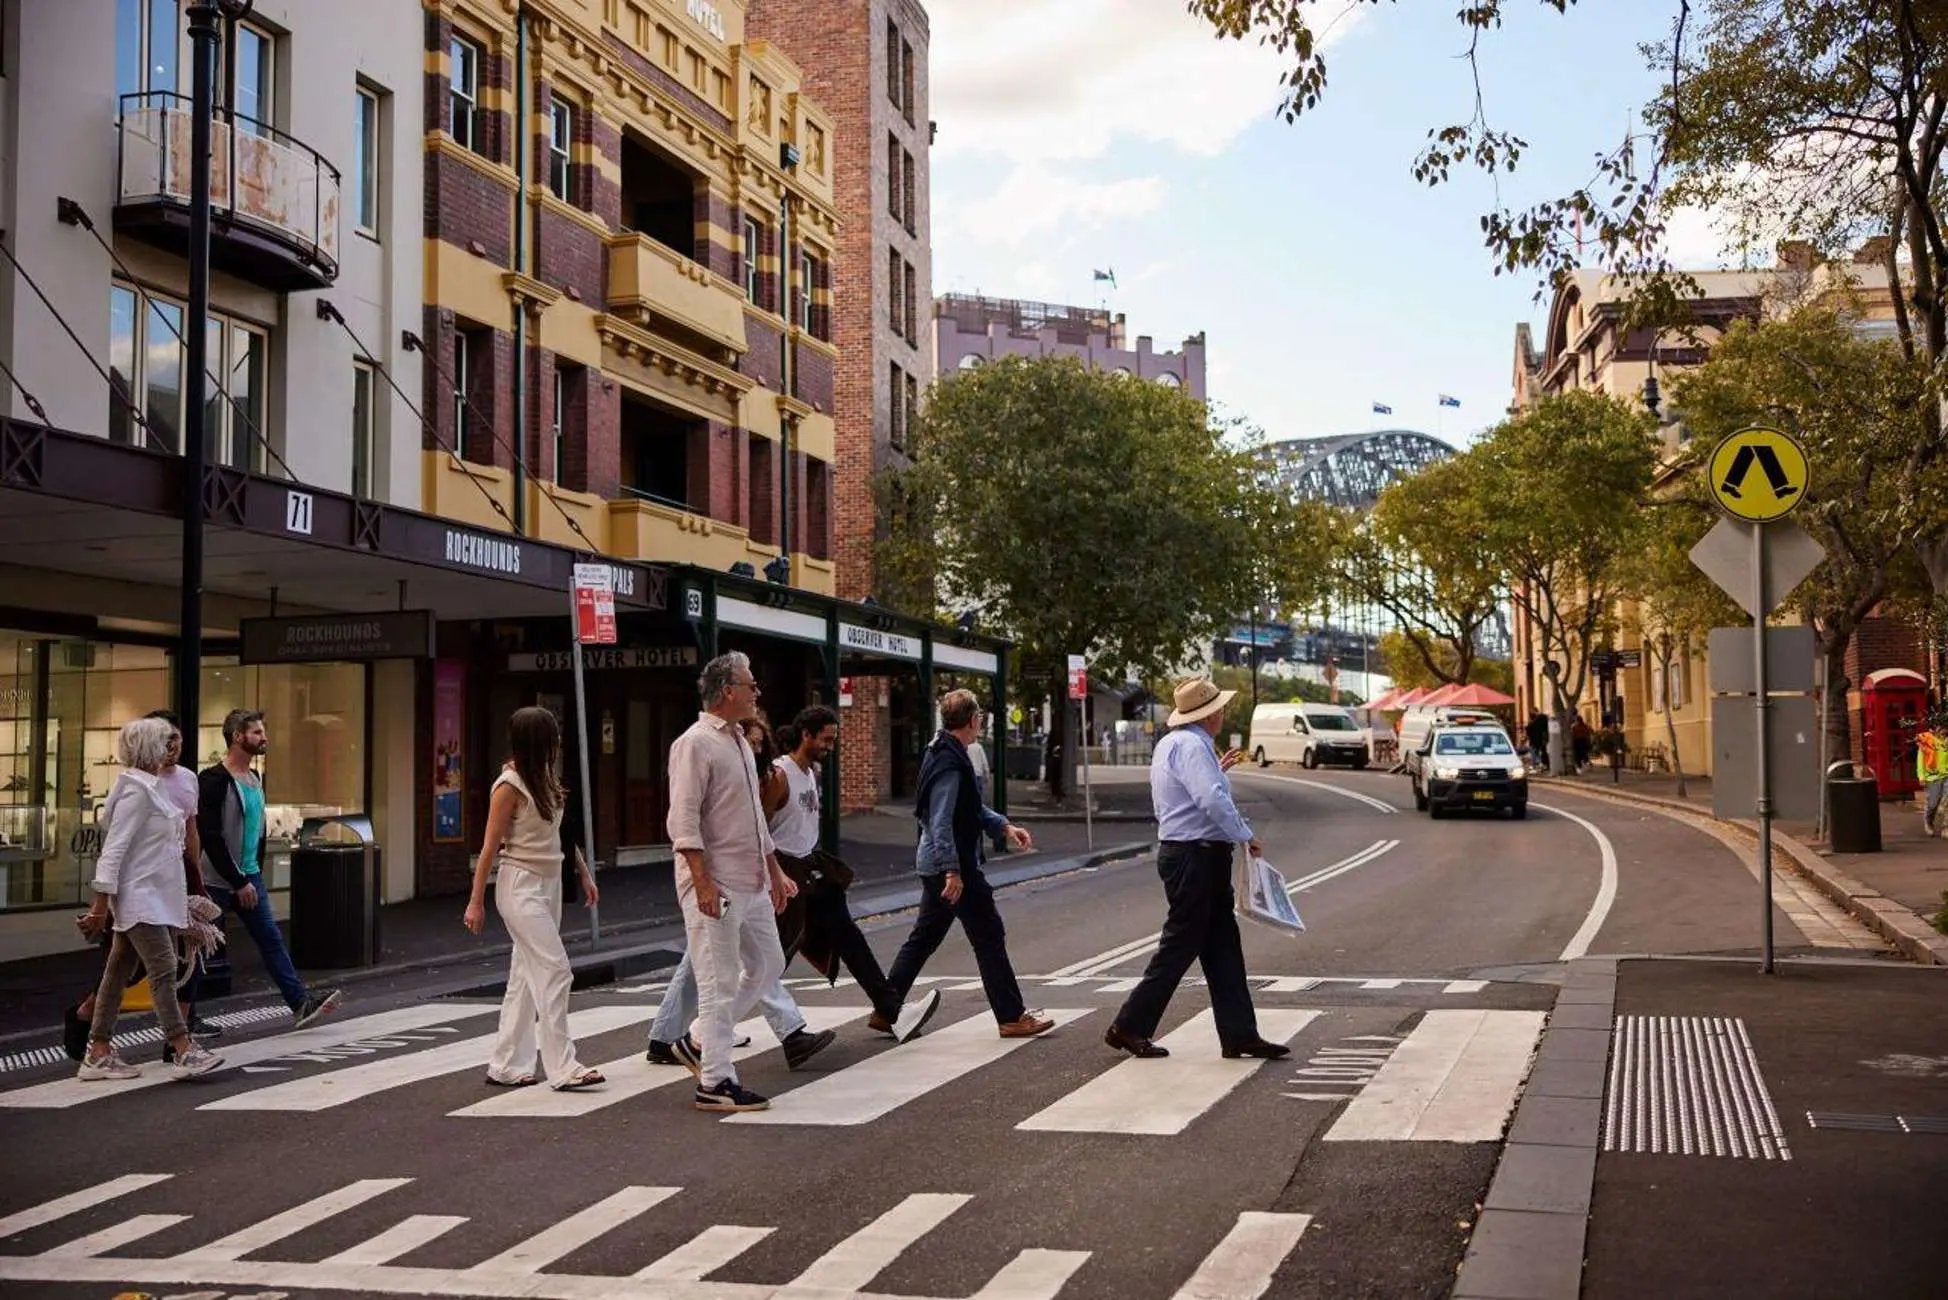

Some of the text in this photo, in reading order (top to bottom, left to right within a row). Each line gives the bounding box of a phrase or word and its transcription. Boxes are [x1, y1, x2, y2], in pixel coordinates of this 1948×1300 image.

[292, 495, 309, 530] 71
[446, 531, 634, 595] ROCKHOUNDS PALS
[286, 623, 382, 643] ROCKHOUNDS
[847, 626, 908, 654] OBSERVER HOTEL
[635, 647, 688, 666] HOTEL
